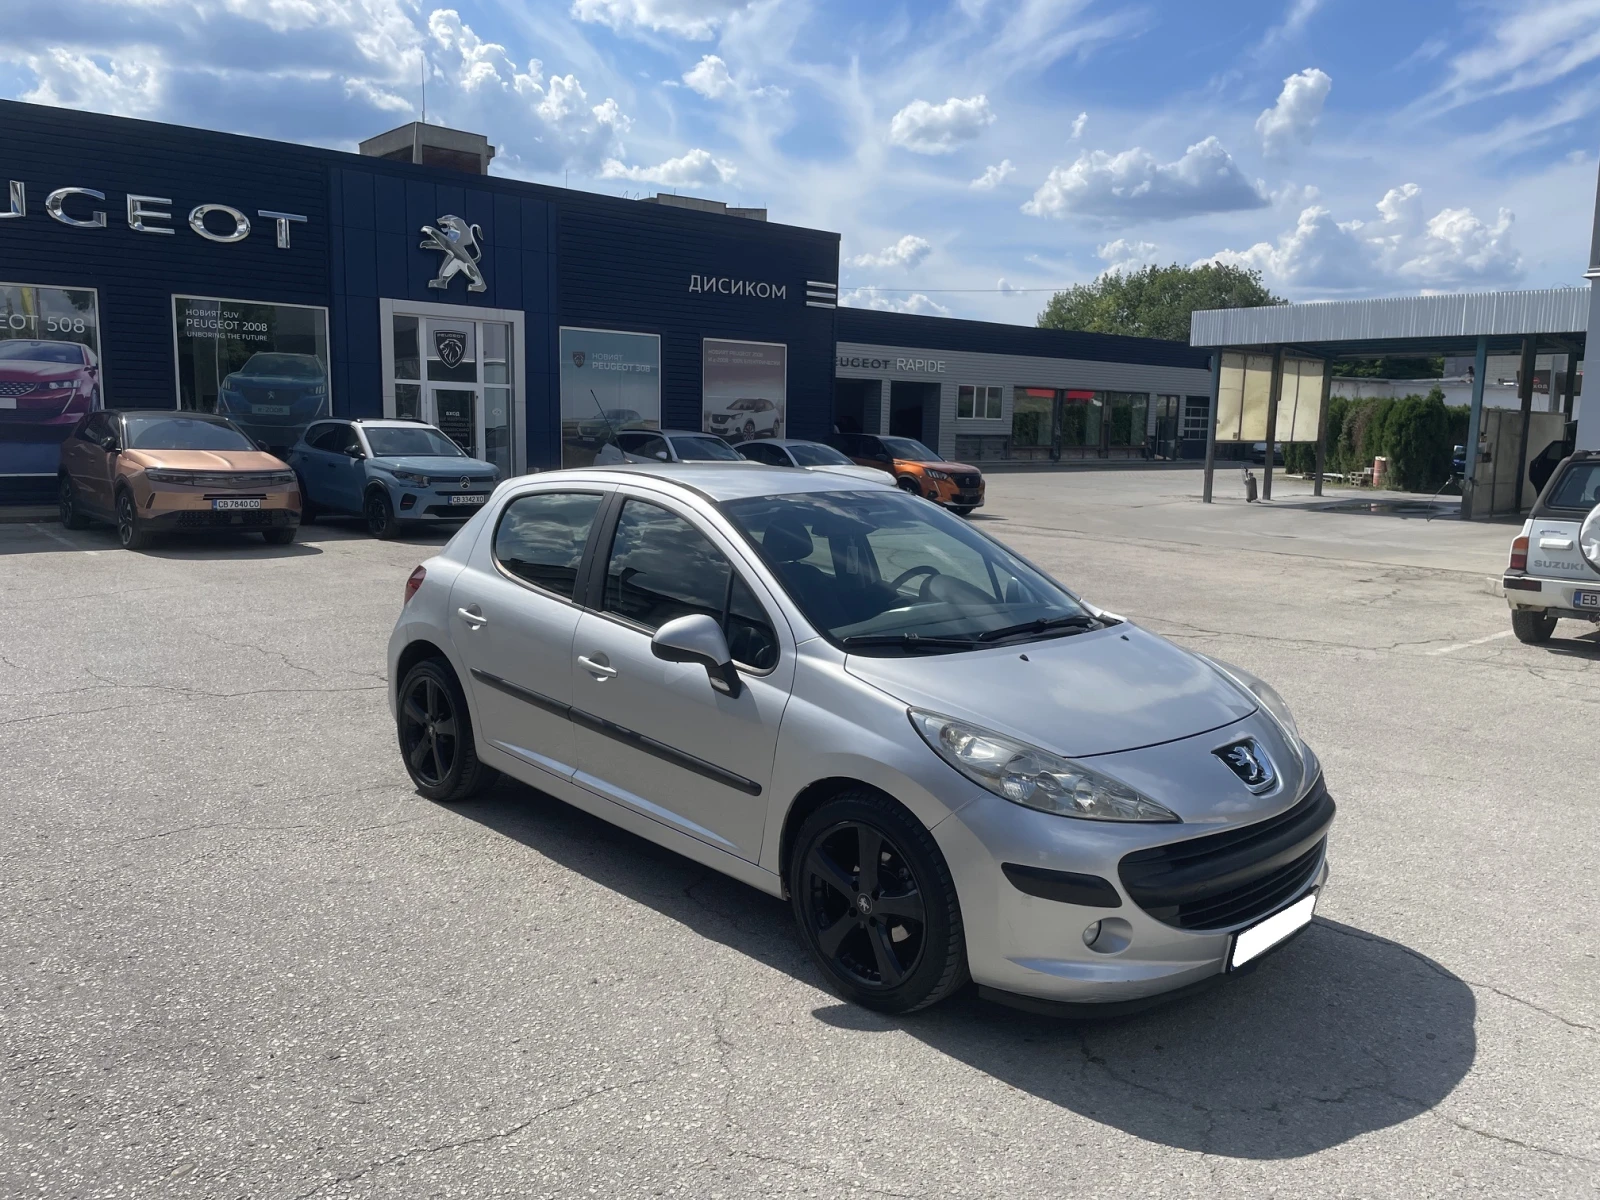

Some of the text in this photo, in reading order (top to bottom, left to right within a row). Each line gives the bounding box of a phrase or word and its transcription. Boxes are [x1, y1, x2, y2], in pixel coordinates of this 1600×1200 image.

[689, 274, 786, 299] ДИСИКОМ
[185, 308, 221, 317] НОВИЯТ
[47, 316, 85, 333] 508
[186, 318, 268, 332] PEUGEOT 2008
[186, 331, 226, 339] UNBORING
[242, 333, 268, 341] FUTURE
[592, 352, 624, 361] НОВИЯТ
[592, 361, 651, 373] PEUGEOT 308
[896, 358, 946, 373] RAPIDE
[218, 500, 229, 508] CB
[229, 500, 249, 508] 7840
[1533, 559, 1585, 571] SUZUKI
